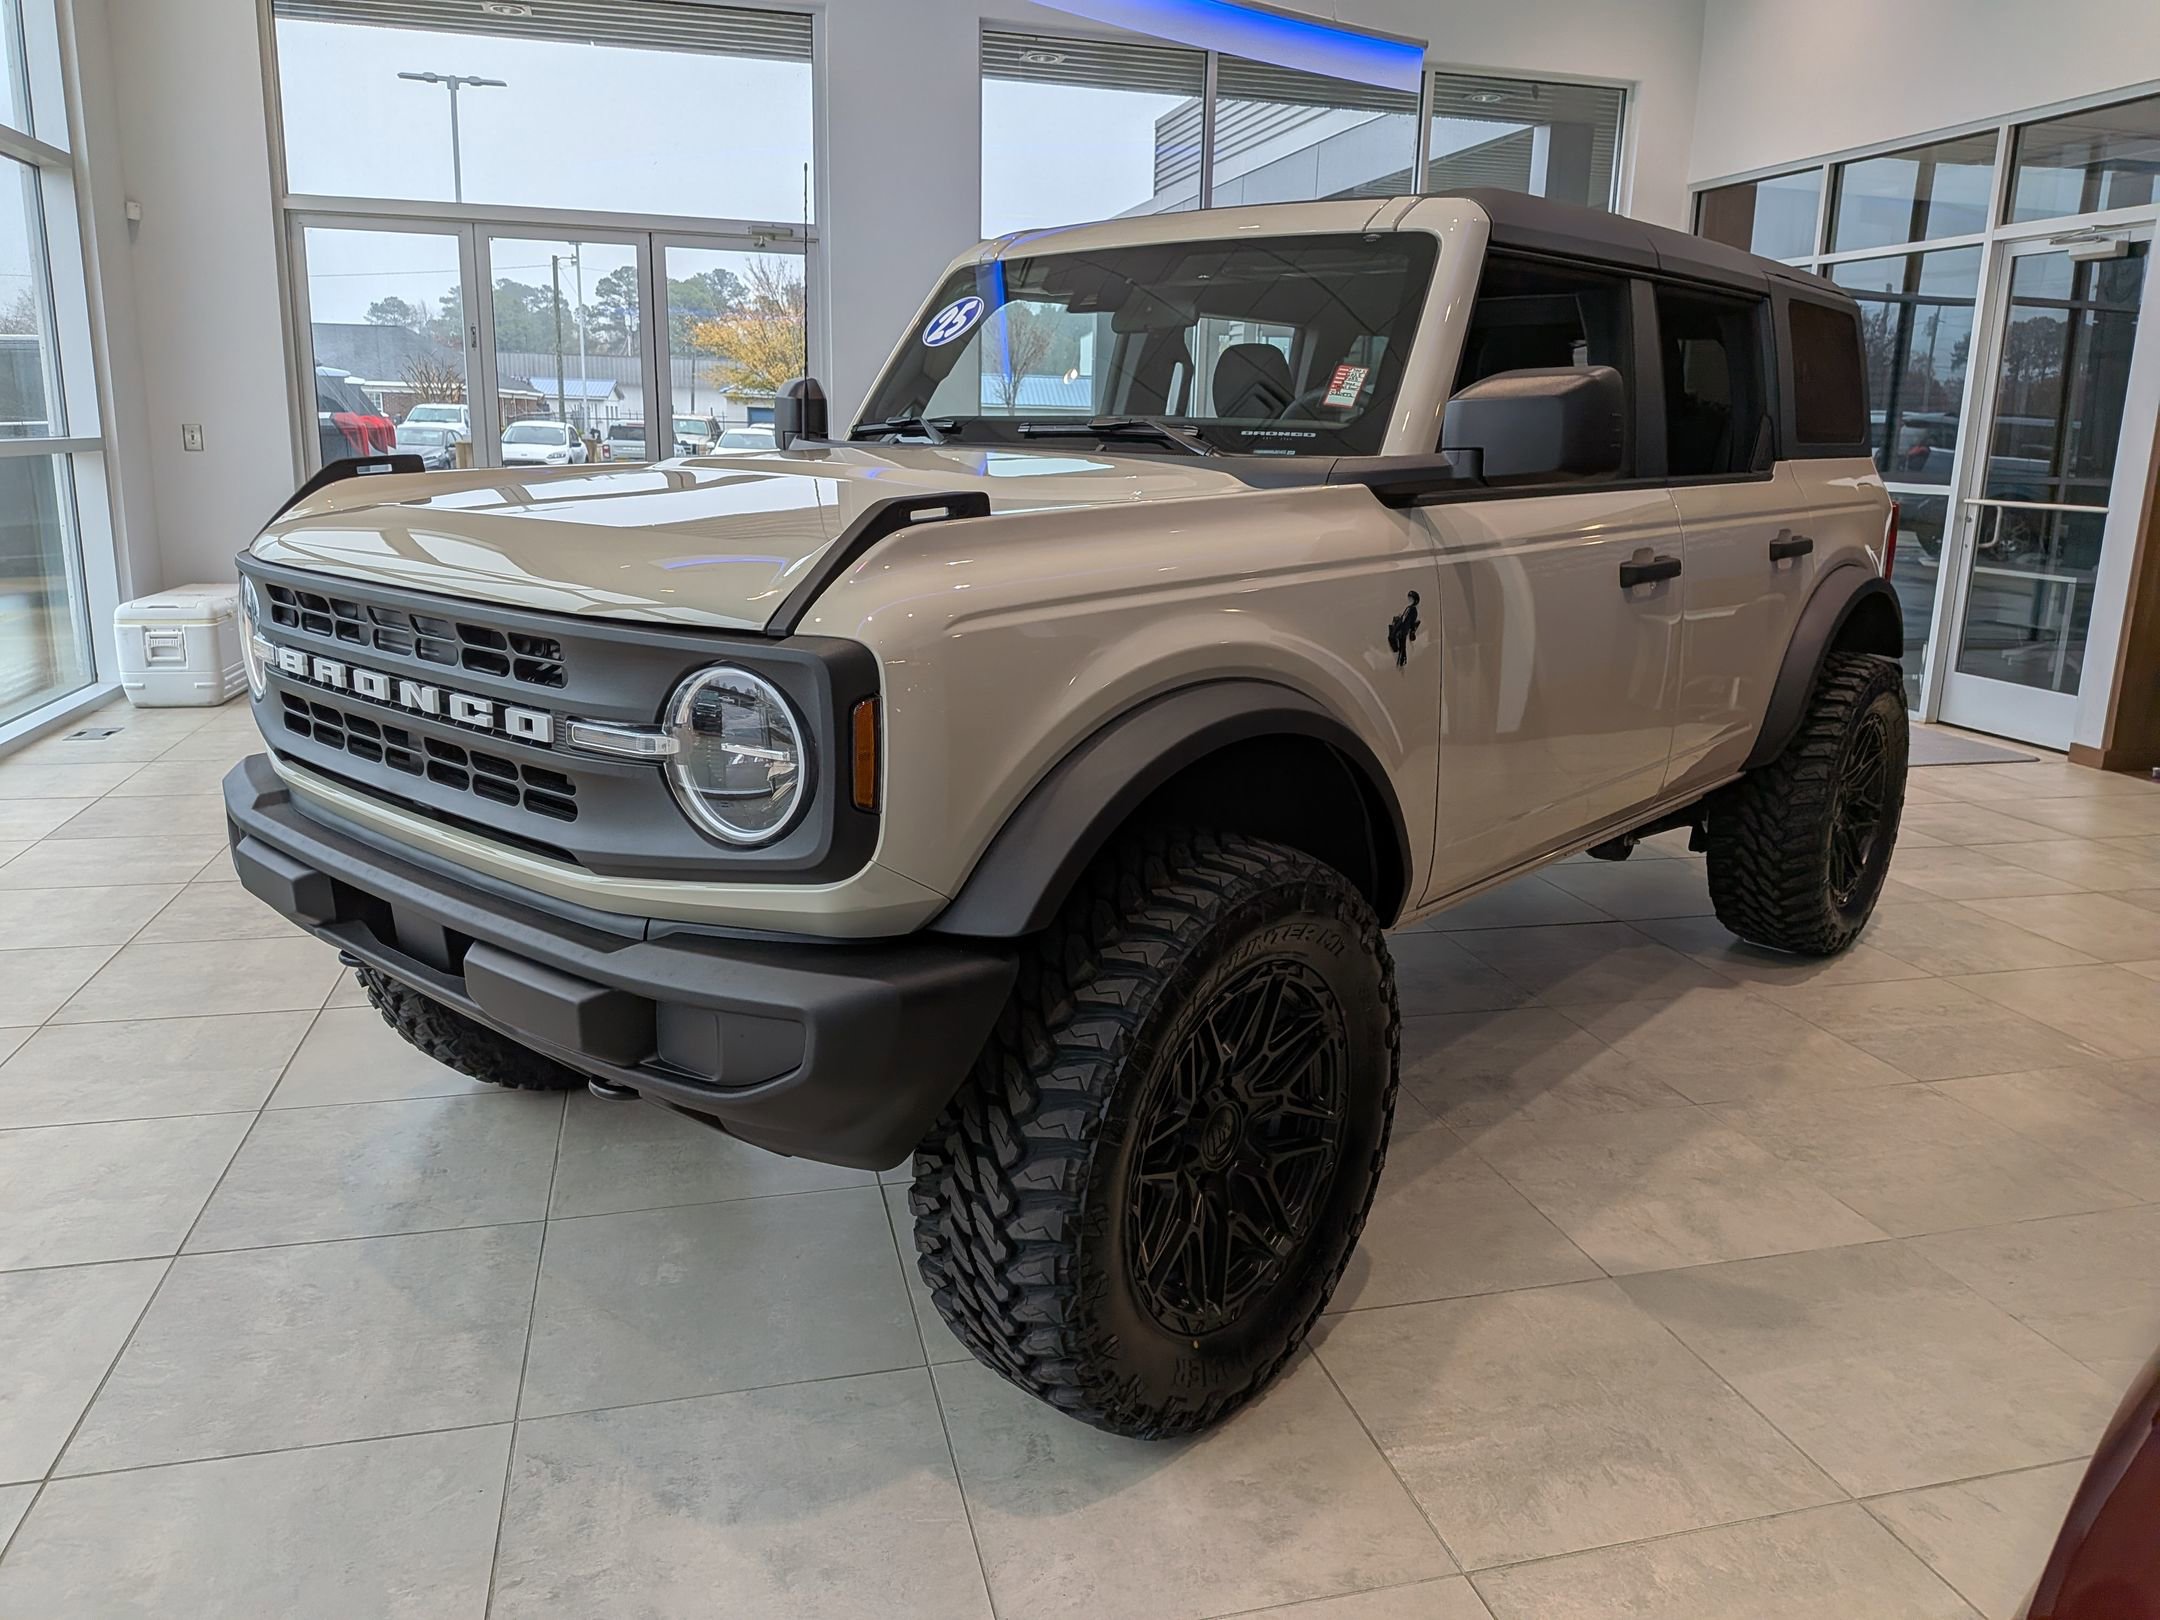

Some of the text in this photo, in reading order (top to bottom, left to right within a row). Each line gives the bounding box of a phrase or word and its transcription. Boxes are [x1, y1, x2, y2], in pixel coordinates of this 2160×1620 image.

[926, 299, 979, 343] 25
[1240, 430, 1317, 438] BRONCO
[278, 646, 555, 744] BRONCO
